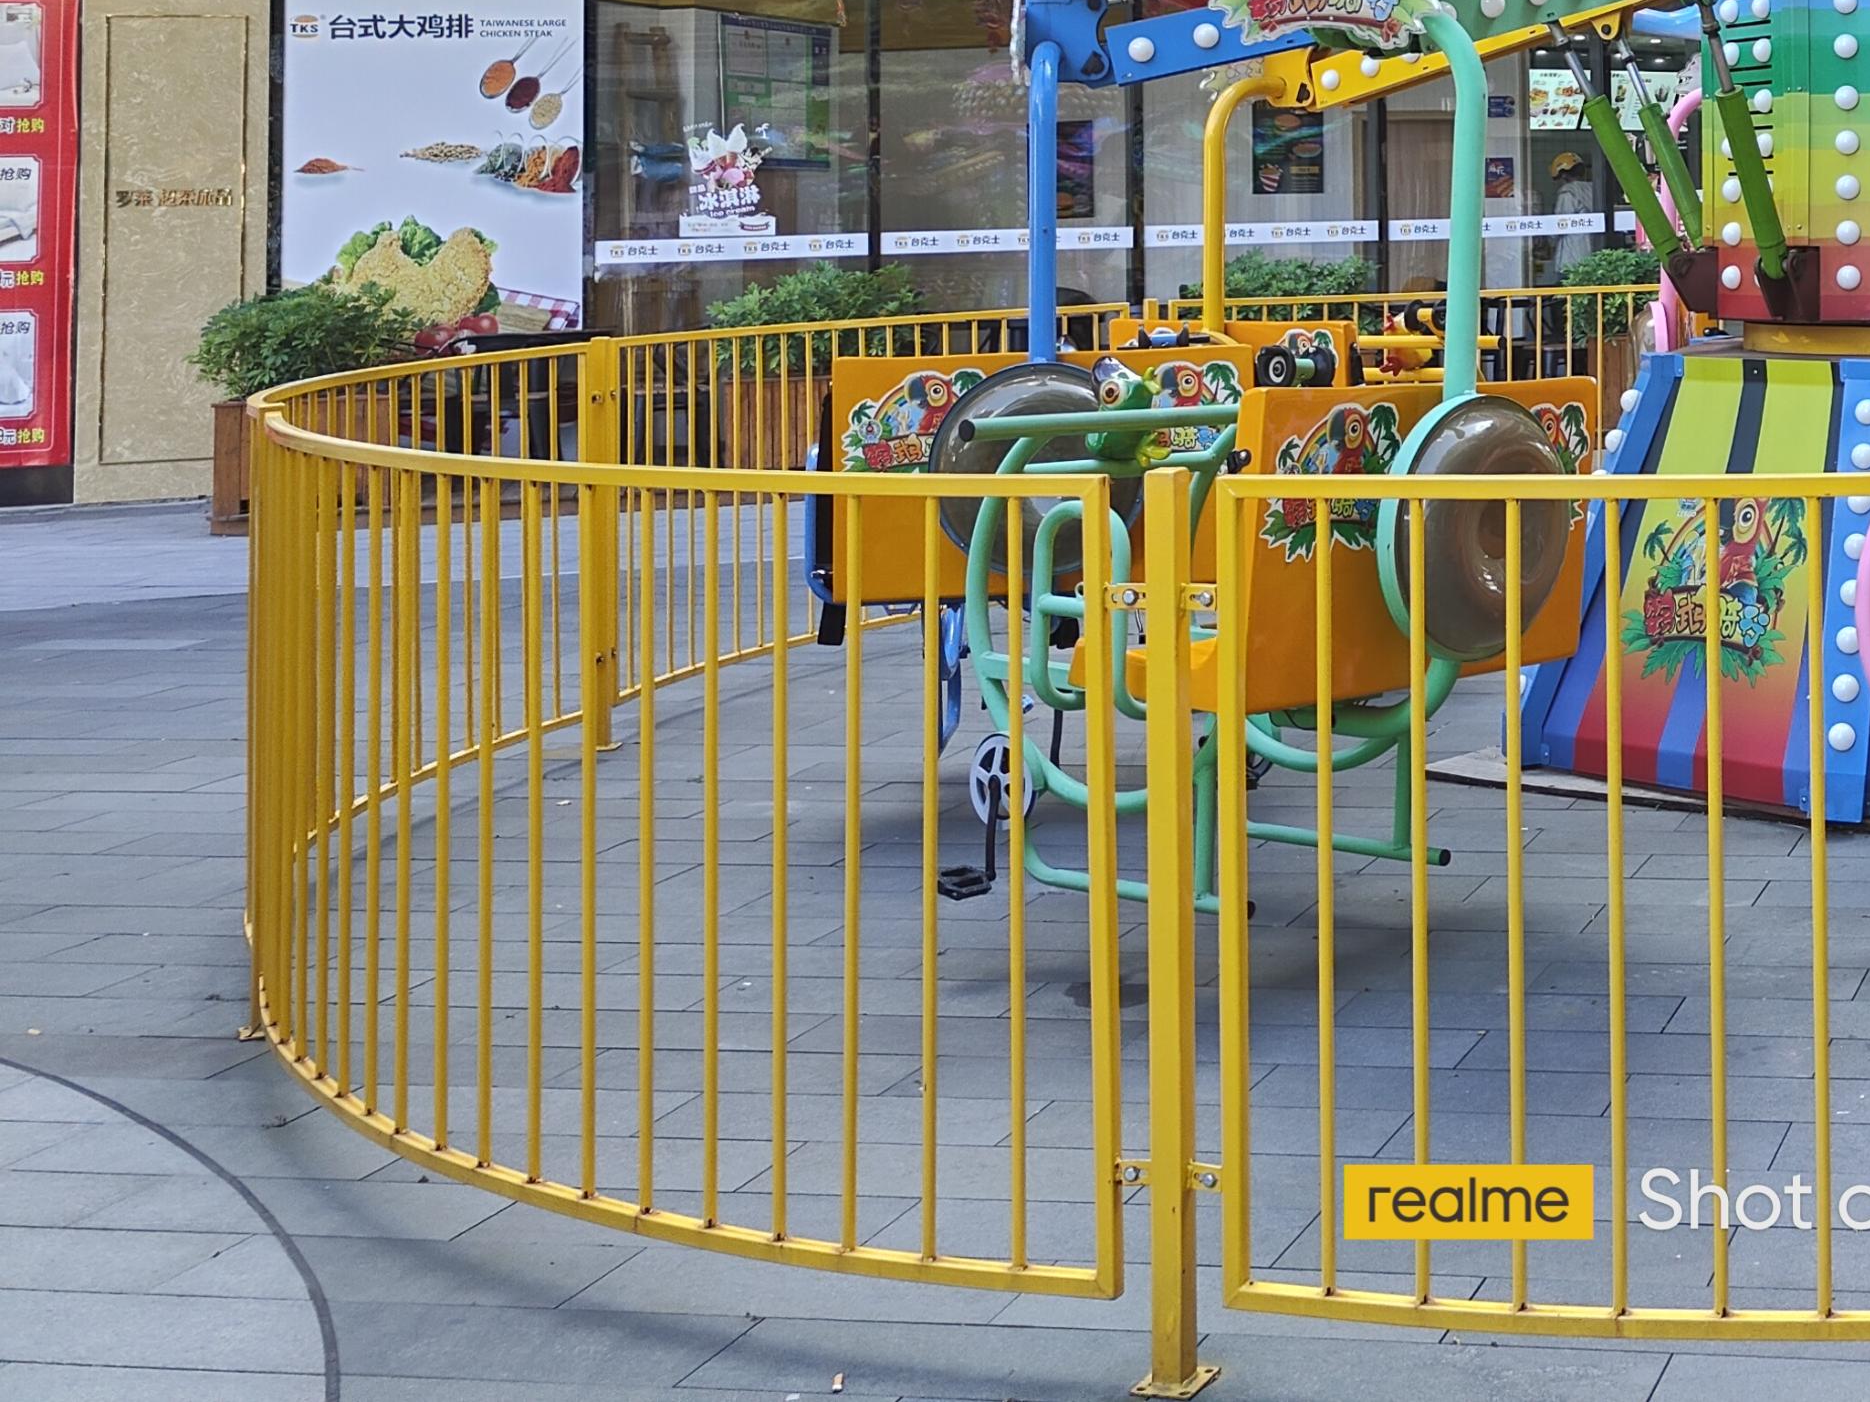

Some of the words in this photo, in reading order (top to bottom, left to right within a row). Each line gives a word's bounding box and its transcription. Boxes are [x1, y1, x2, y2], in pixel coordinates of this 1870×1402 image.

[290, 23, 319, 33] TKS
[329, 14, 475, 39] 台式大鸡排
[480, 19, 535, 28] TAIWANESE
[537, 19, 567, 27] LARGE
[480, 30, 522, 38] CHICKEN
[524, 30, 553, 38] STEAK
